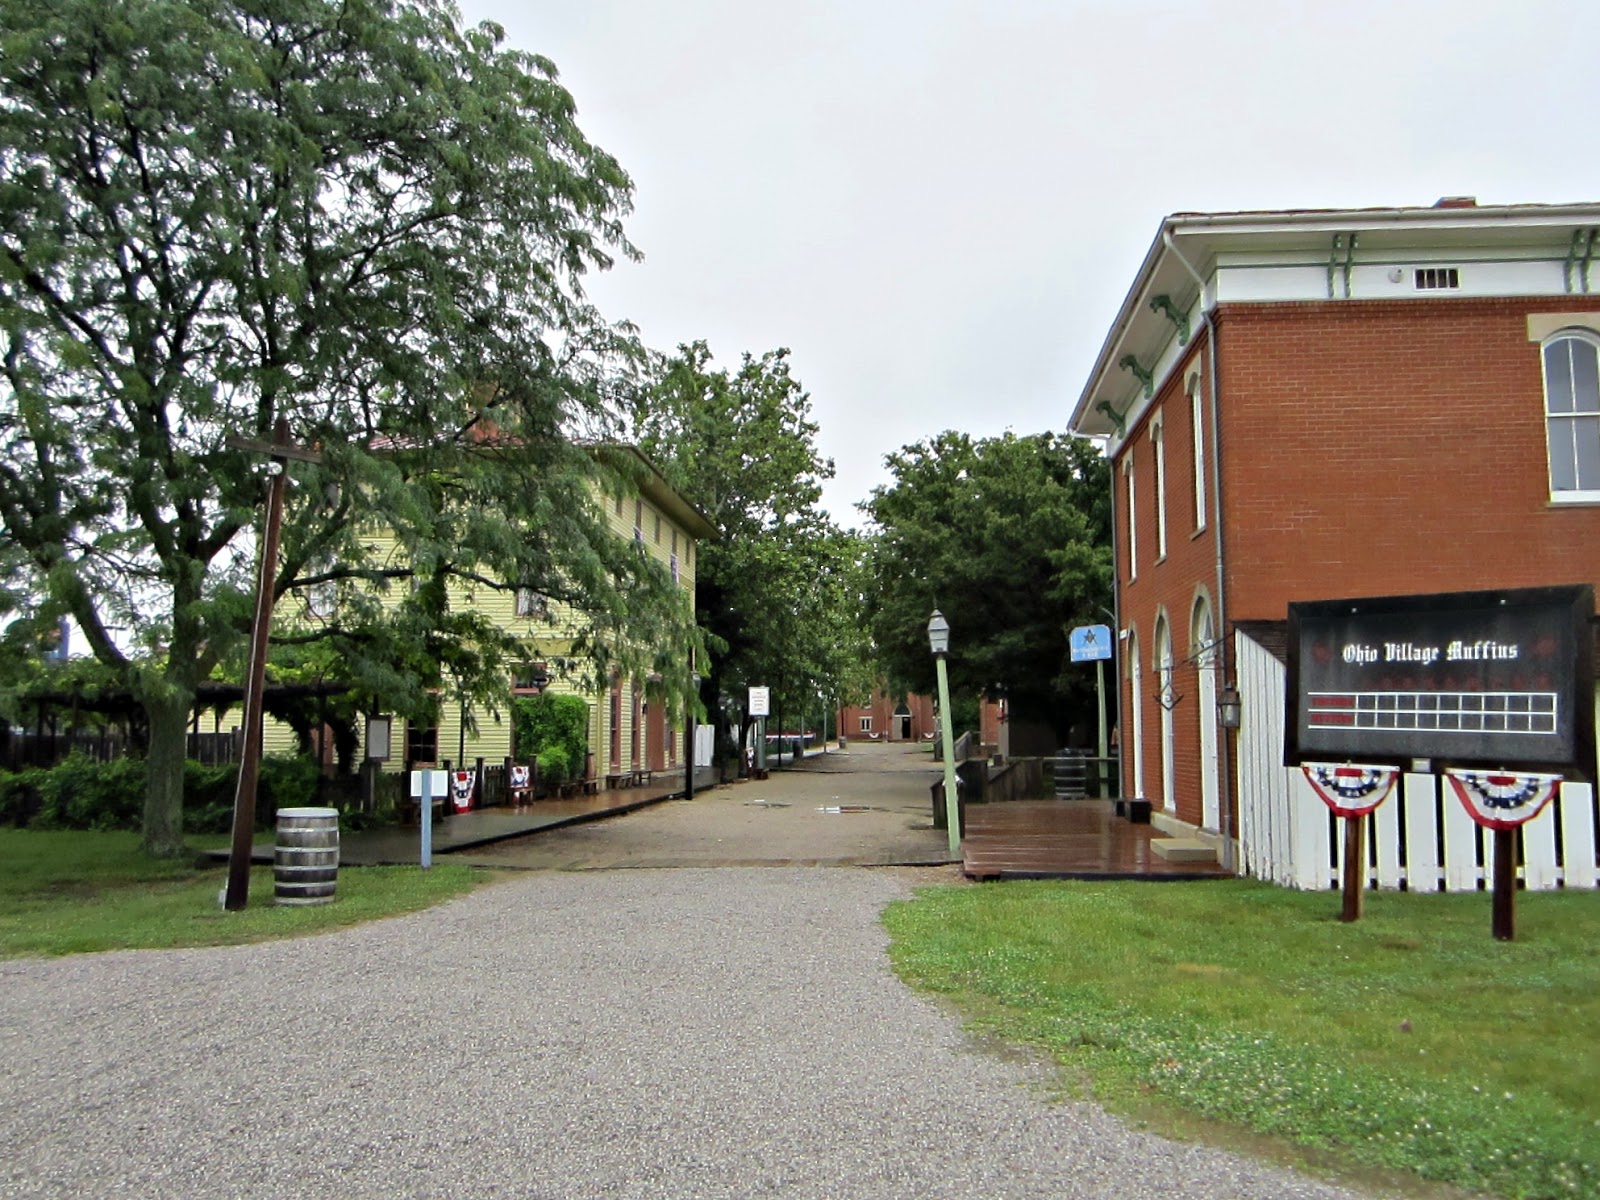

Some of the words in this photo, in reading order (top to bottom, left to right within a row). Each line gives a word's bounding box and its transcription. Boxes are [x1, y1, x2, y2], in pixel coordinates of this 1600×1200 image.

[1343, 643, 1378, 666] Ohio
[1384, 642, 1439, 665] Village
[1446, 640, 1518, 661] Muffins
